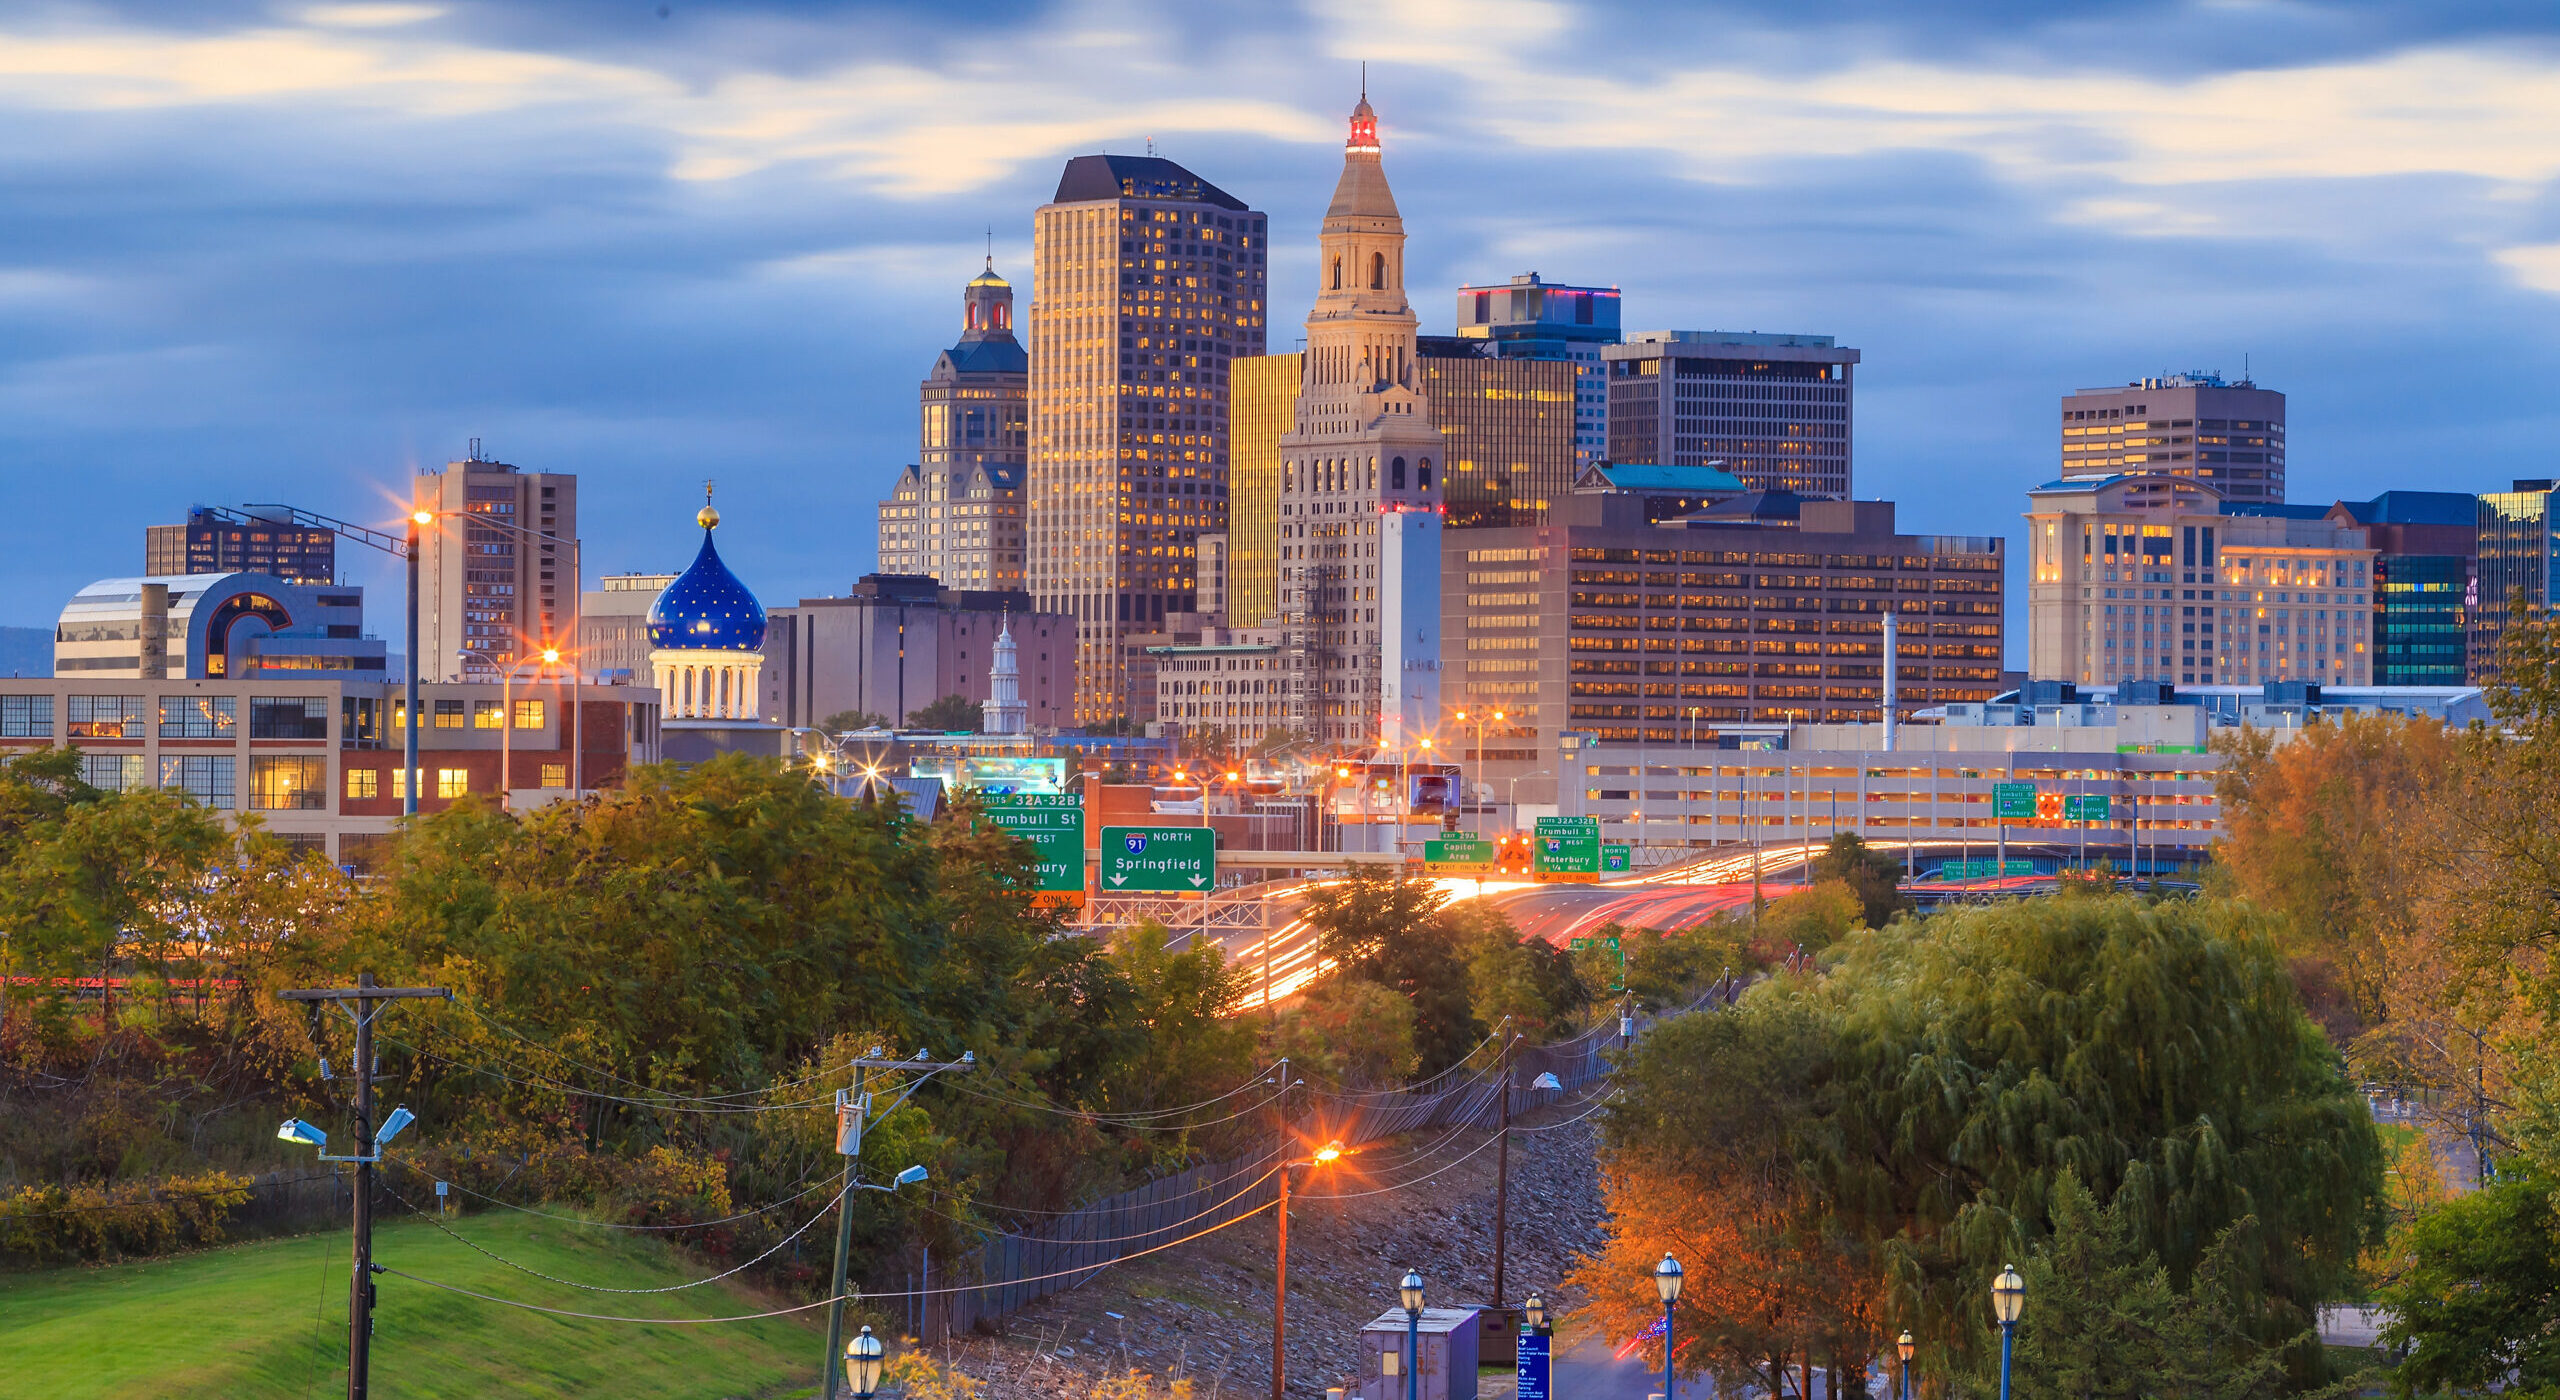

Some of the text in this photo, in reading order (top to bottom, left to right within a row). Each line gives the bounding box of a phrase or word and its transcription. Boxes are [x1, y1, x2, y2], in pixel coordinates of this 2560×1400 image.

[1016, 795, 1076, 806] 32A-32B
[2070, 806, 2104, 814] Sprngfield
[1061, 813, 1076, 825] St
[1557, 817, 1594, 825] 32A-32B
[1538, 827, 1579, 835] Trumbull
[1027, 834, 1056, 843] WEST
[1153, 832, 1192, 842] NORTH
[1128, 839, 1142, 850] 91
[1443, 842, 1475, 851] Capitol
[1449, 852, 1470, 860] Area
[1543, 855, 1590, 866] Waterbury
[1116, 857, 1201, 873] Springfield
